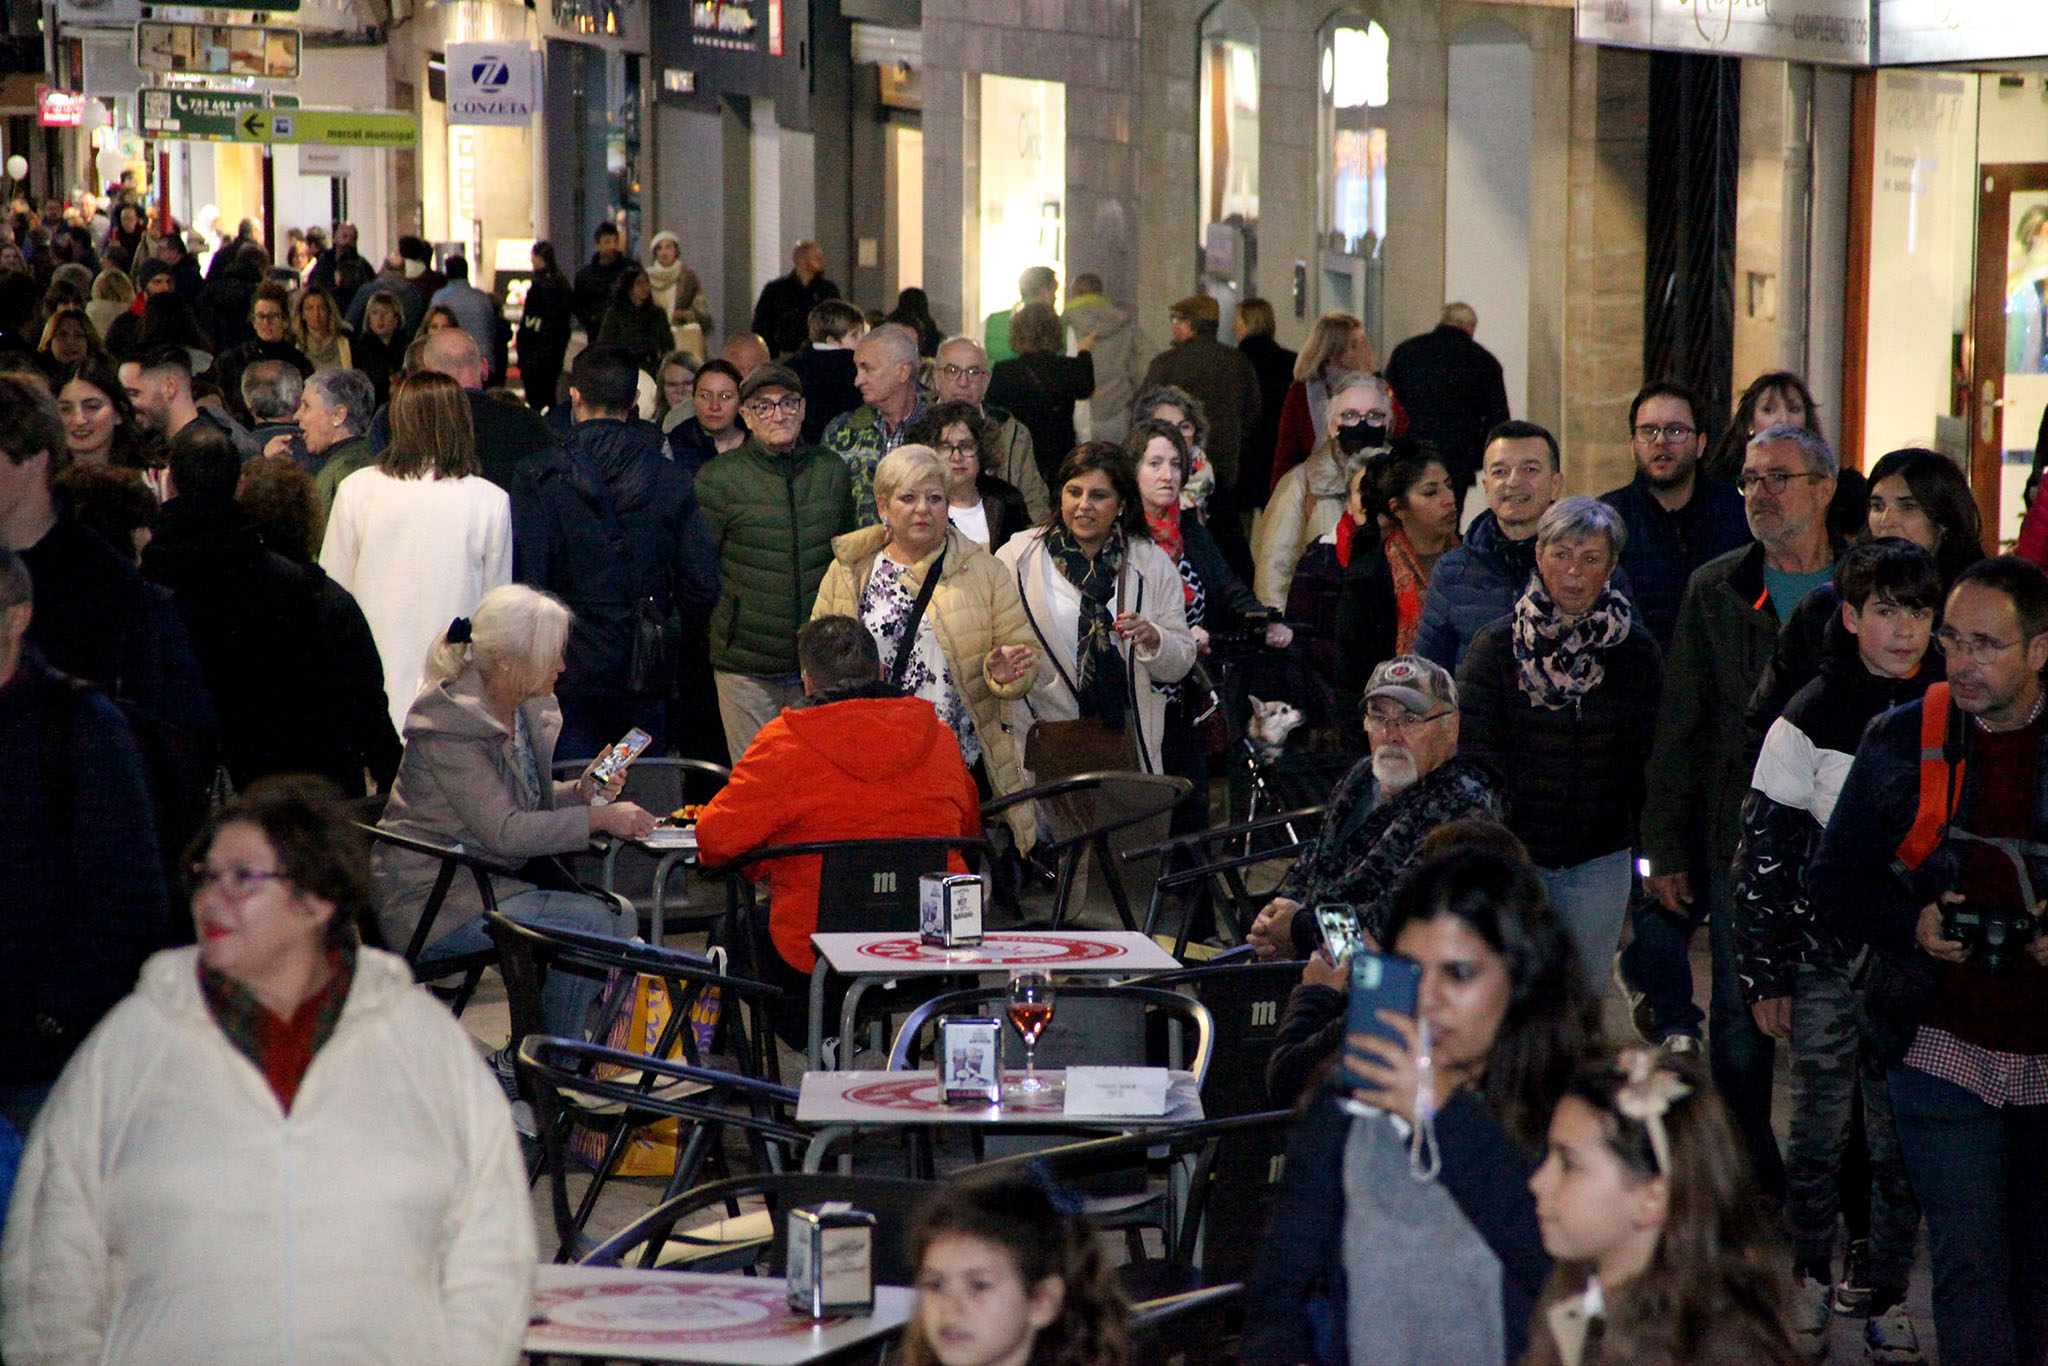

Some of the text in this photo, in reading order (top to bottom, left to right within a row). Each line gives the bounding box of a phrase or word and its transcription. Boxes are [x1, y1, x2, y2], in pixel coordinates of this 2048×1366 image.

[1793, 13, 1868, 46] COMPLEMENTOS
[453, 102, 528, 115] CONZETA
[364, 129, 415, 142] municipal
[872, 872, 897, 893] m
[1252, 1001, 1277, 1026] m
